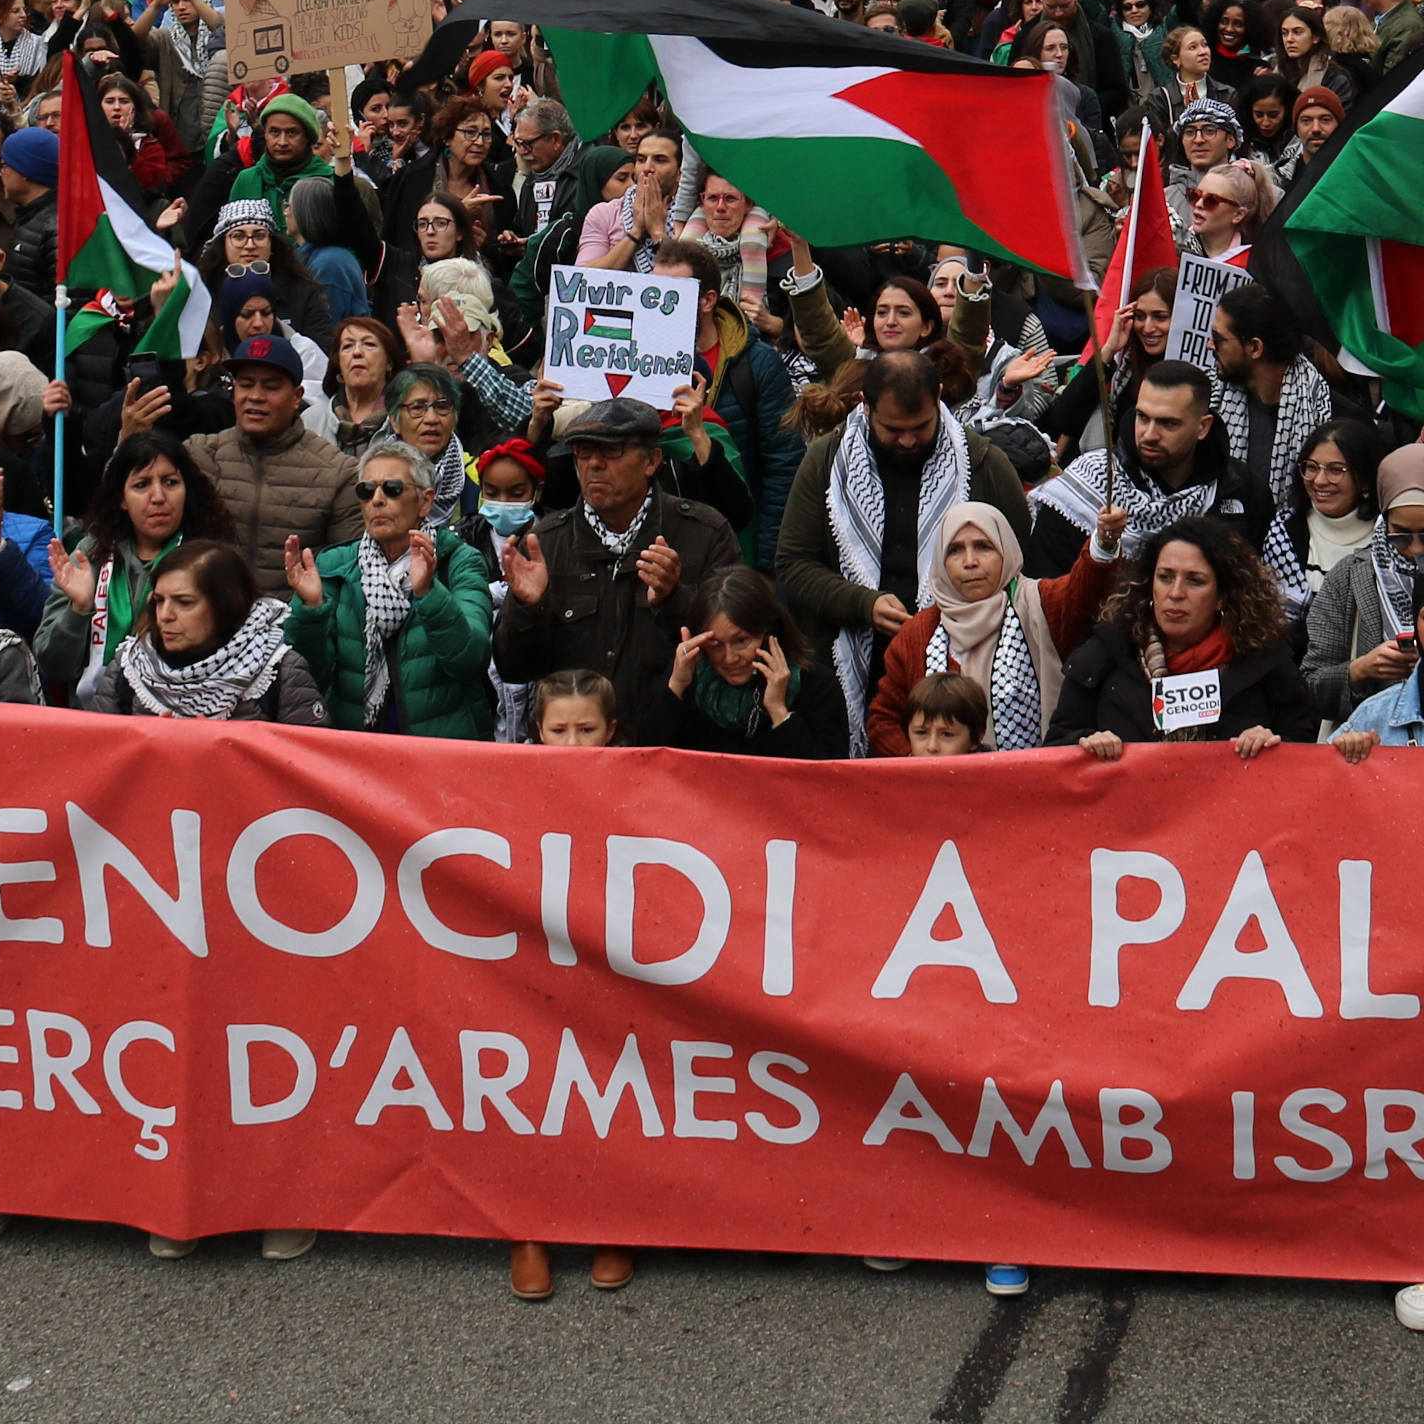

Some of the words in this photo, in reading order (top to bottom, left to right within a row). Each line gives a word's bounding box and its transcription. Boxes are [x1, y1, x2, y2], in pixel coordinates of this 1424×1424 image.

[553, 270, 633, 306] Vivir
[640, 286, 680, 316] es
[1182, 260, 1231, 304] FROM
[1192, 297, 1213, 333] TO
[549, 306, 693, 378] Resistencia
[1179, 330, 1213, 369] PAL
[1164, 683, 1218, 705] STOP
[1166, 699, 1220, 716] GENOCIDI
[870, 839, 1018, 1004] A
[862, 1072, 1173, 1172] AMB
